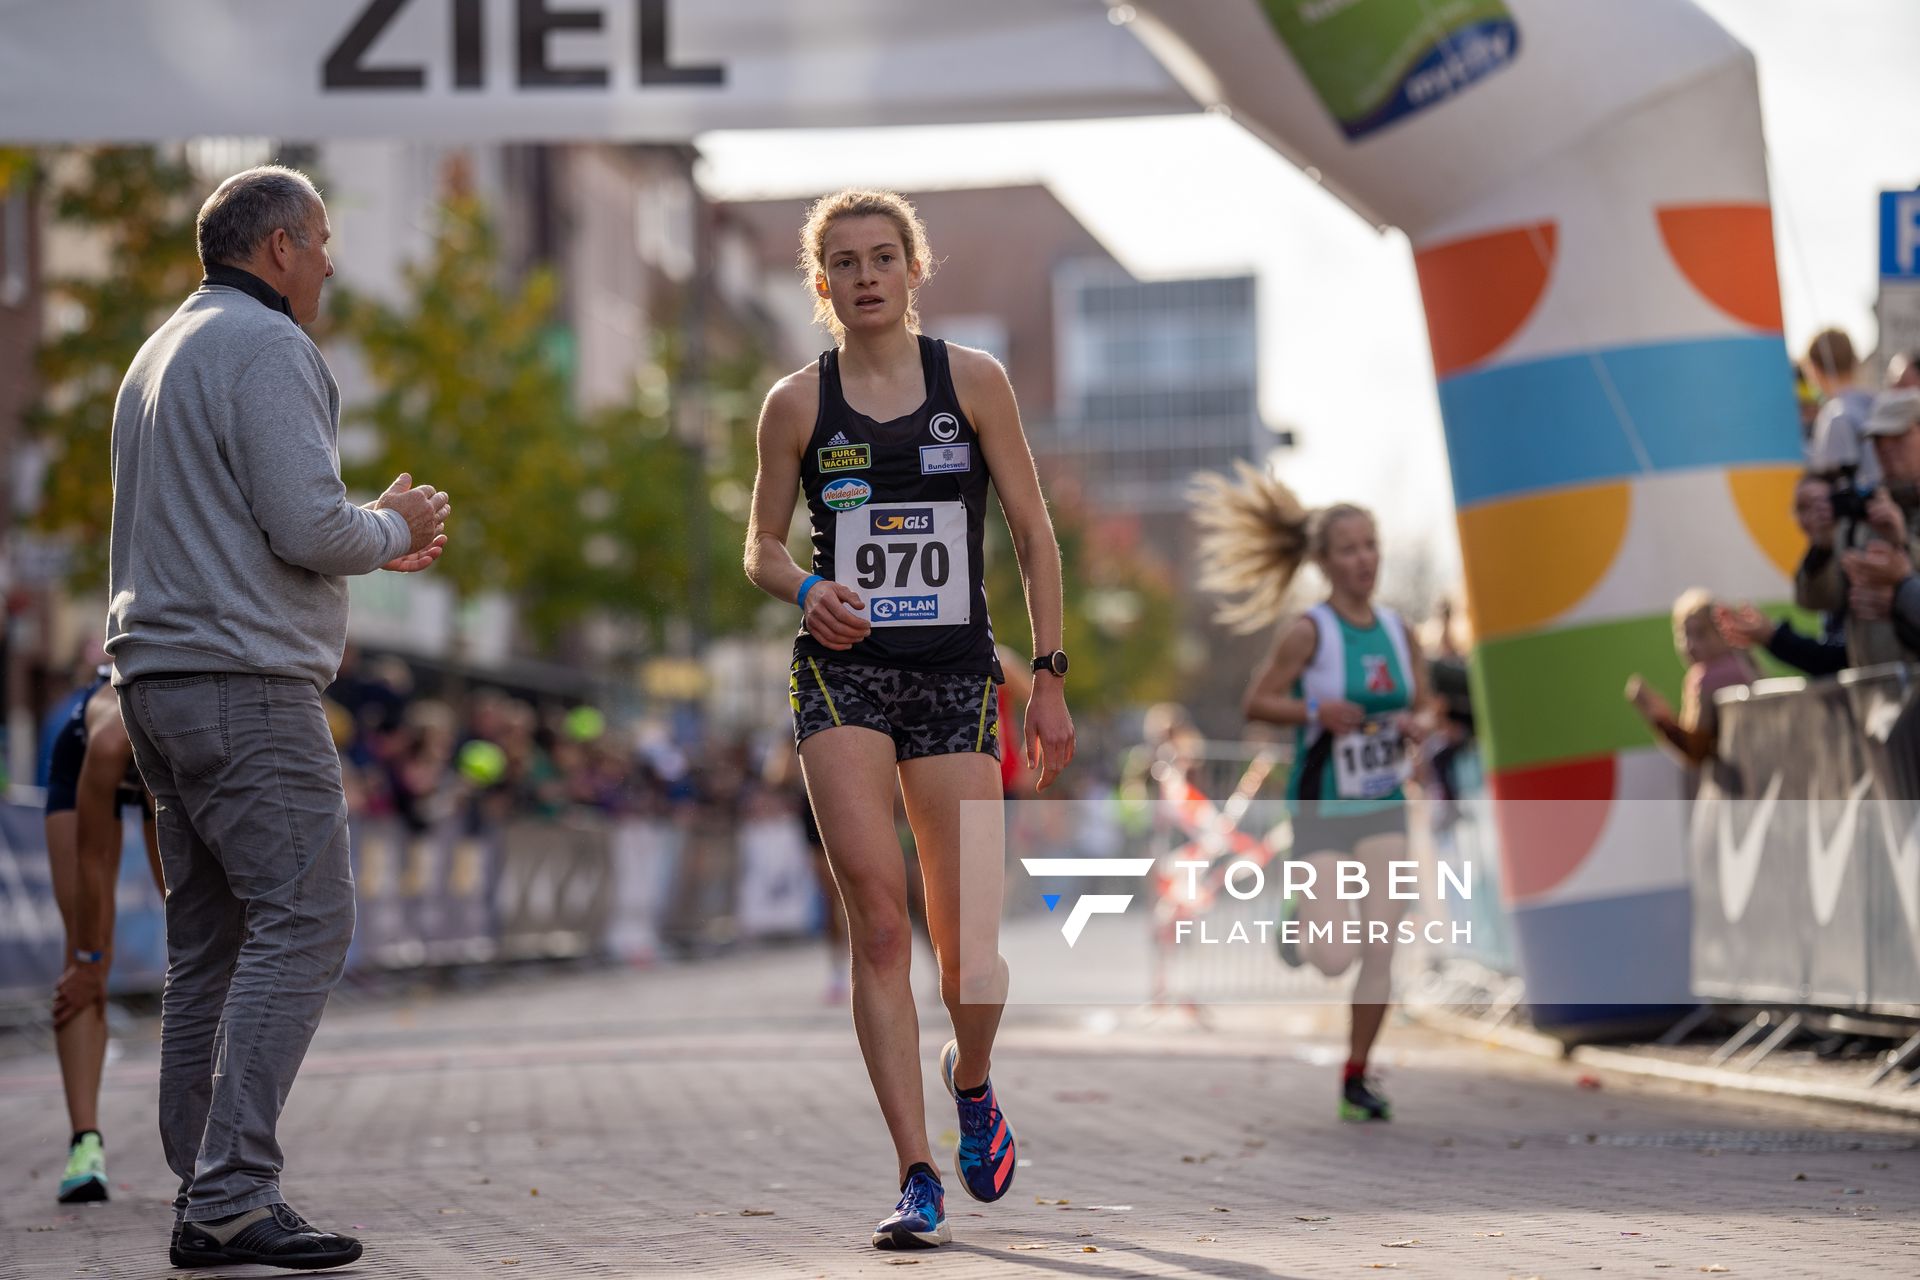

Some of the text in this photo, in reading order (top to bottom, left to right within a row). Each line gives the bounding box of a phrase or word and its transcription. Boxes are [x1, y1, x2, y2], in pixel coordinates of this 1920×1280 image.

[321, 0, 725, 91] ZIEL
[828, 439, 850, 447] adidas
[831, 449, 857, 458] BURG
[823, 457, 866, 468] WÄCHTER
[928, 462, 966, 471] Bundeswehr
[904, 515, 929, 530] GLS
[855, 541, 950, 590] 970
[899, 599, 936, 612] PLAN
